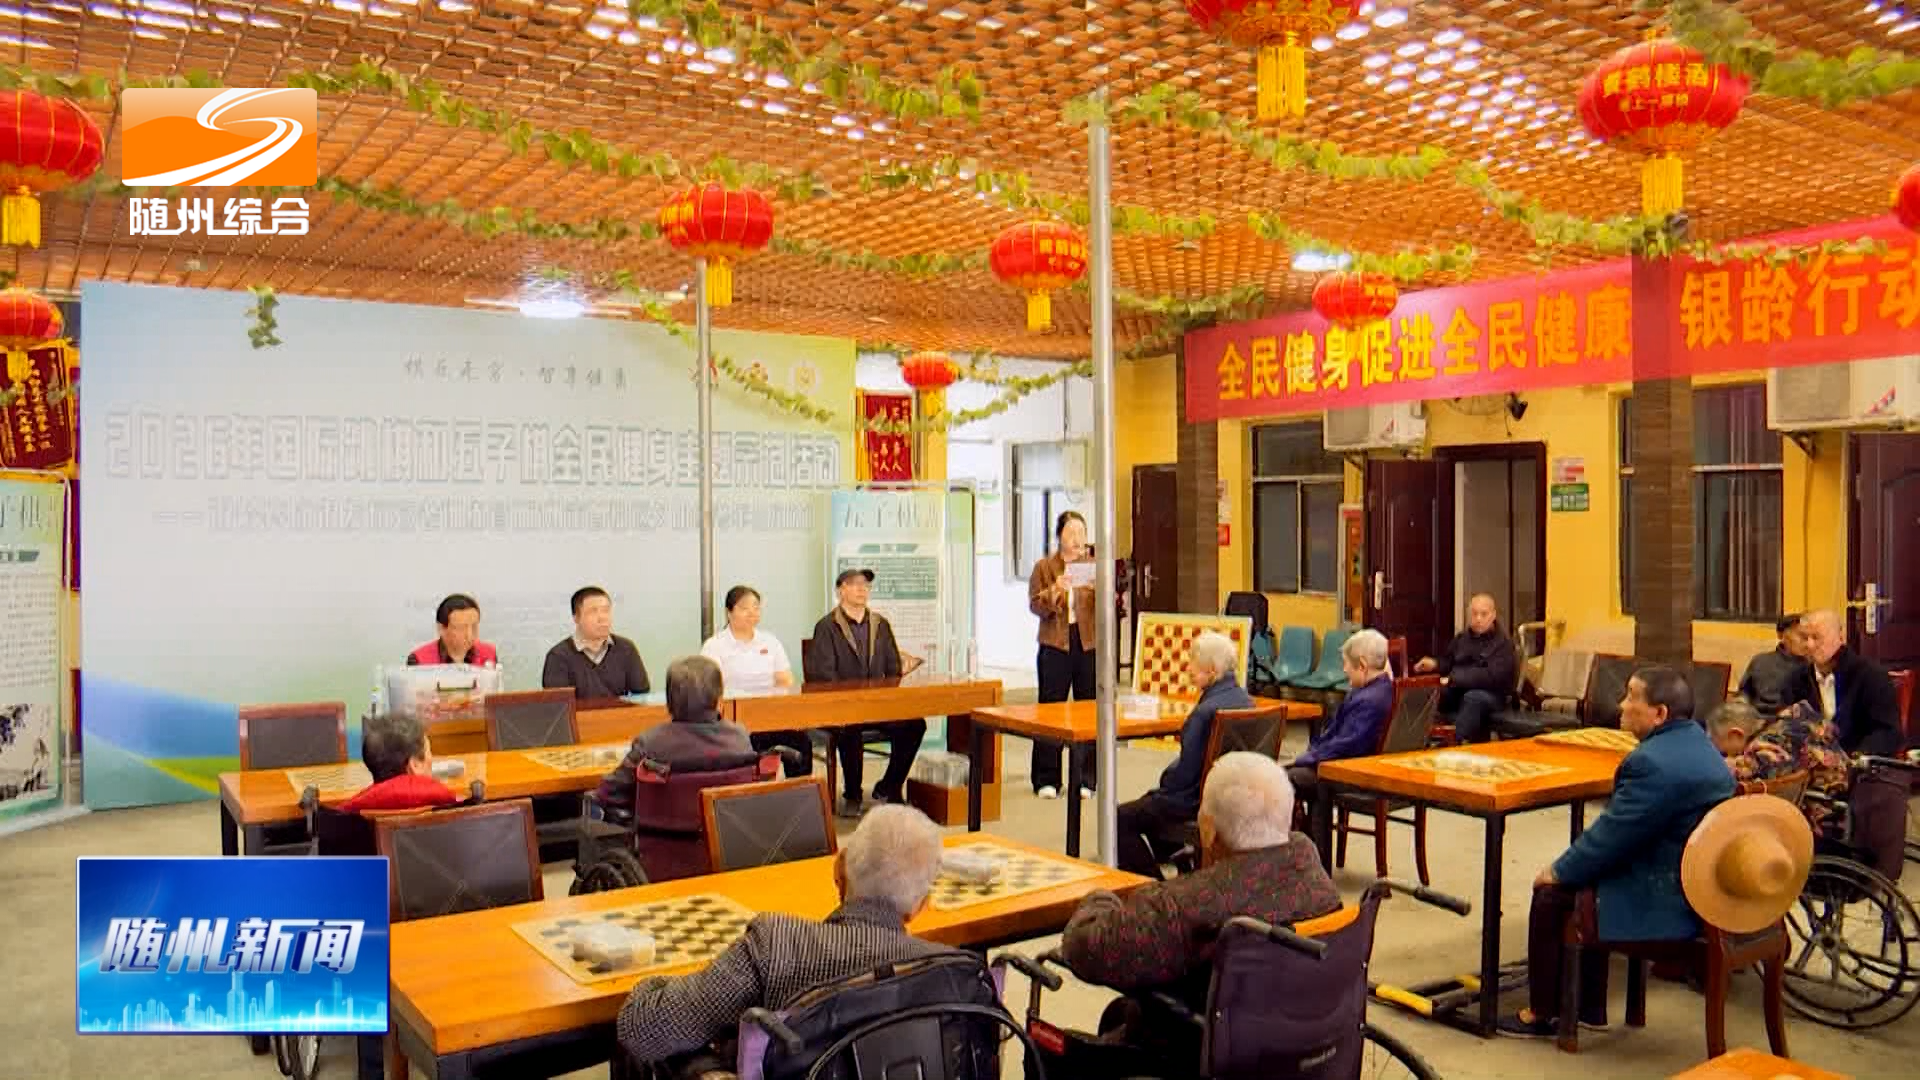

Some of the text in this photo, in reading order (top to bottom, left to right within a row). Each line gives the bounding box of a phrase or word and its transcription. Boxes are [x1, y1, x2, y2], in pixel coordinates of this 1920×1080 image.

[1216, 281, 1632, 400] 全民健身促进全民健康
[1679, 248, 1920, 351] 银龄行动
